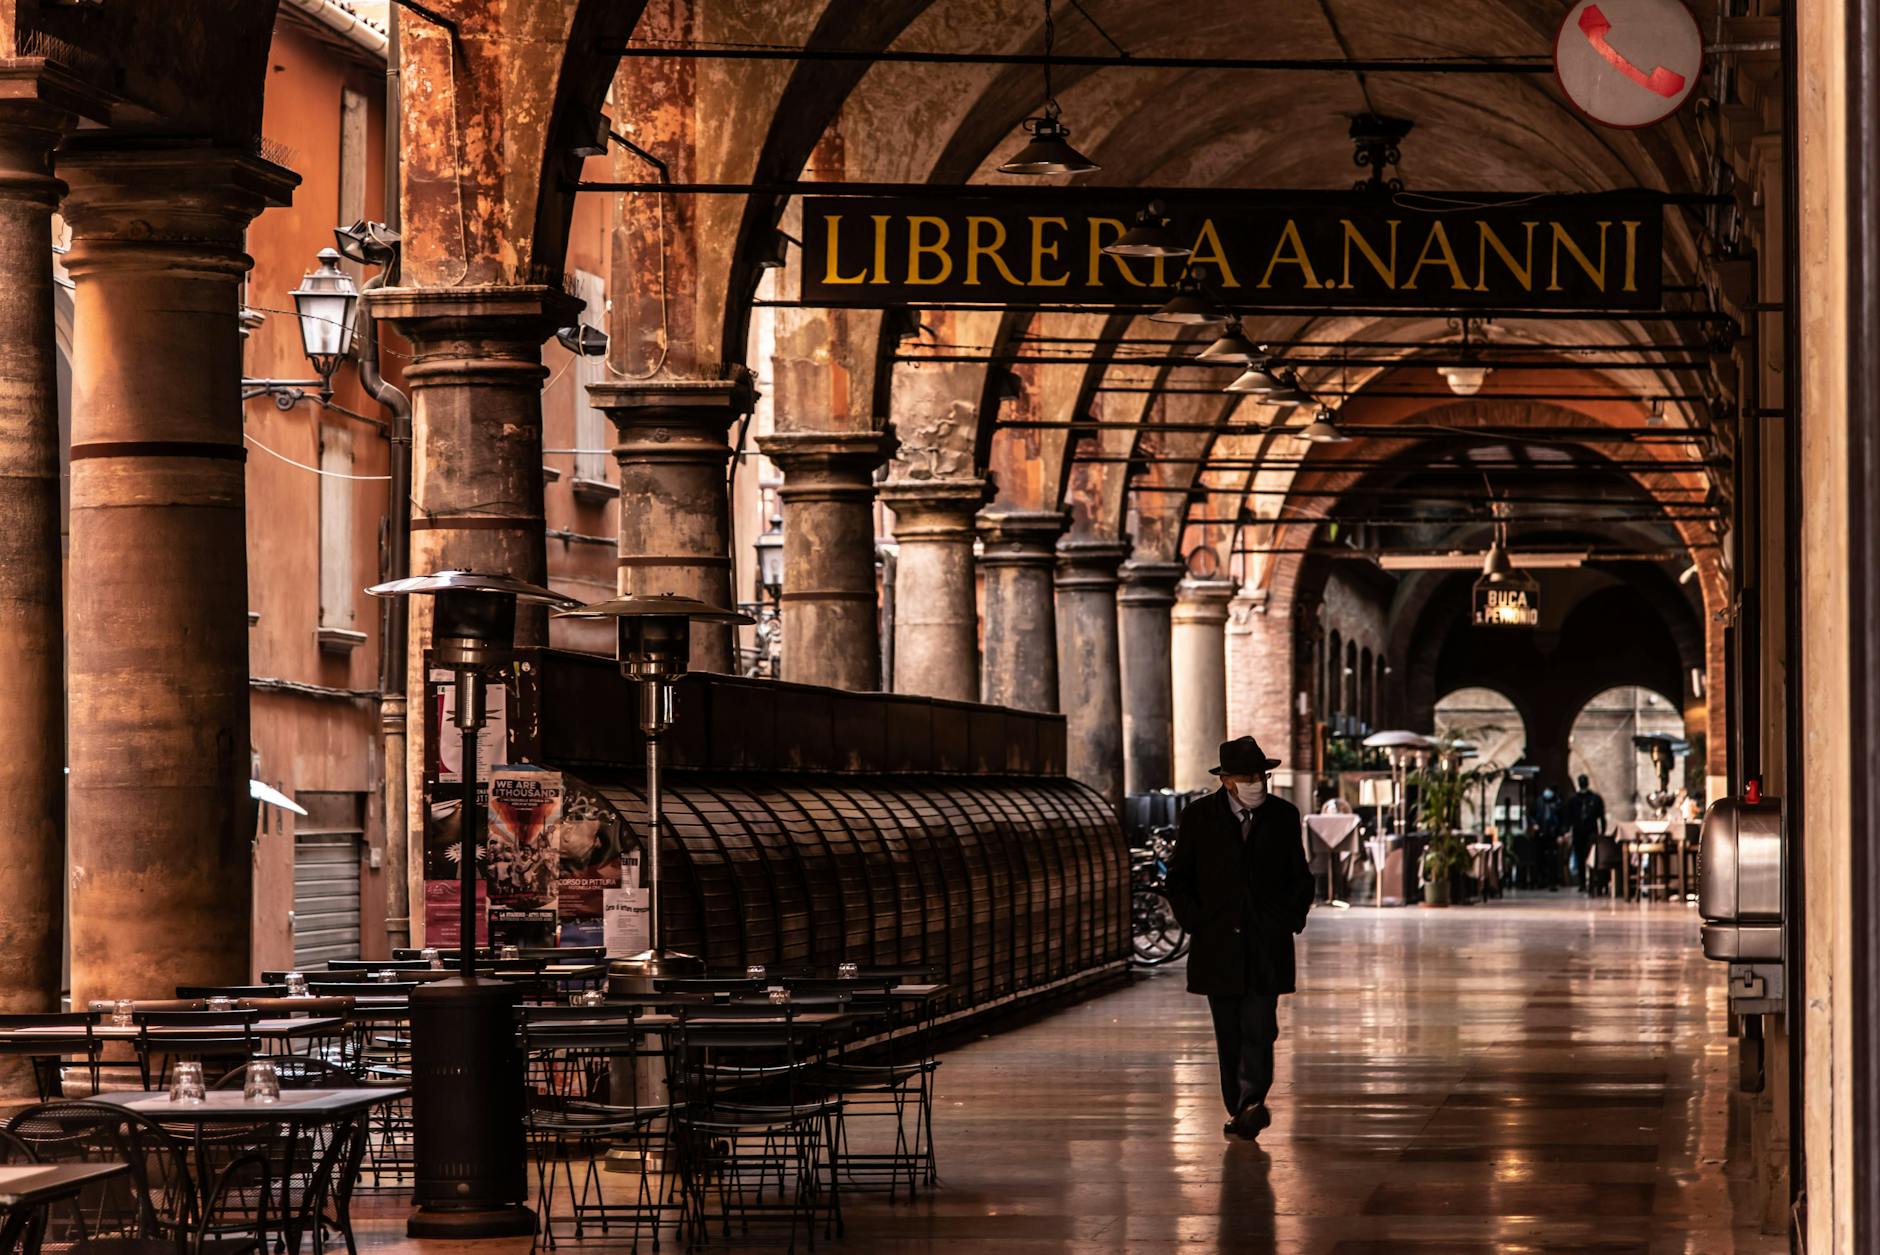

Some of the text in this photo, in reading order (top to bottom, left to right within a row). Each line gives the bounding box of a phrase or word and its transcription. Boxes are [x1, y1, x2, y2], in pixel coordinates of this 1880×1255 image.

[1488, 589, 1528, 607] BUCA
[496, 780, 513, 789] WE
[515, 781, 537, 789] ARE
